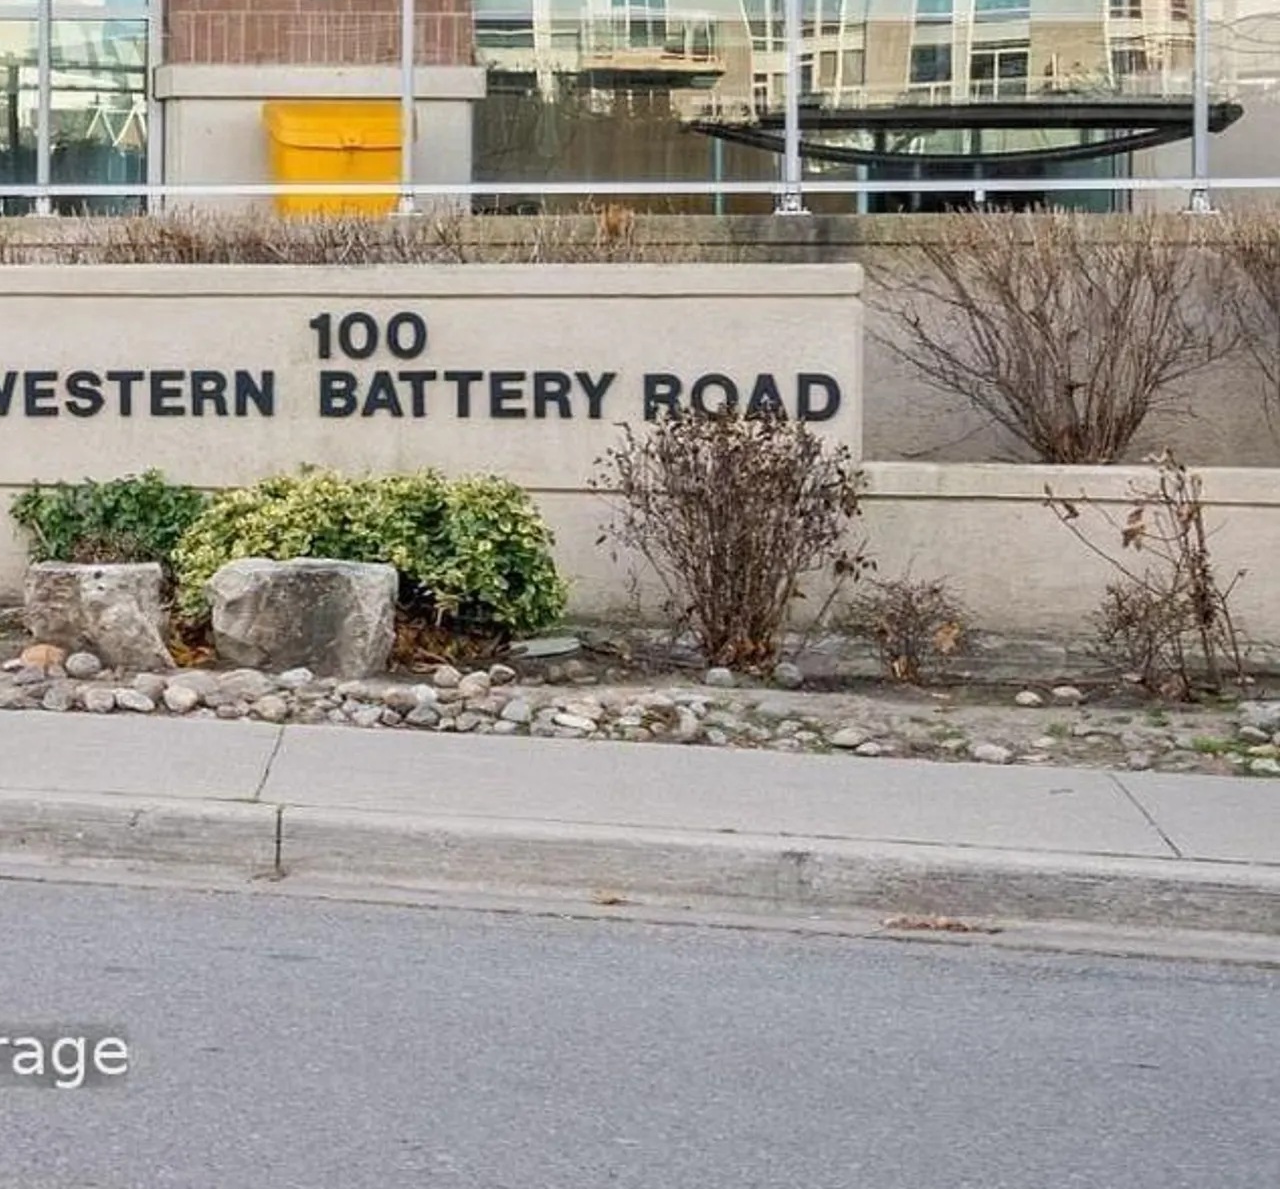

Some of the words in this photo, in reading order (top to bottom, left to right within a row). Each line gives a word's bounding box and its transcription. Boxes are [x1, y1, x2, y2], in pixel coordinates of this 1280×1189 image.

[308, 311, 428, 360] 100
[318, 370, 618, 420] BATTERY
[643, 372, 842, 422] ROAD
